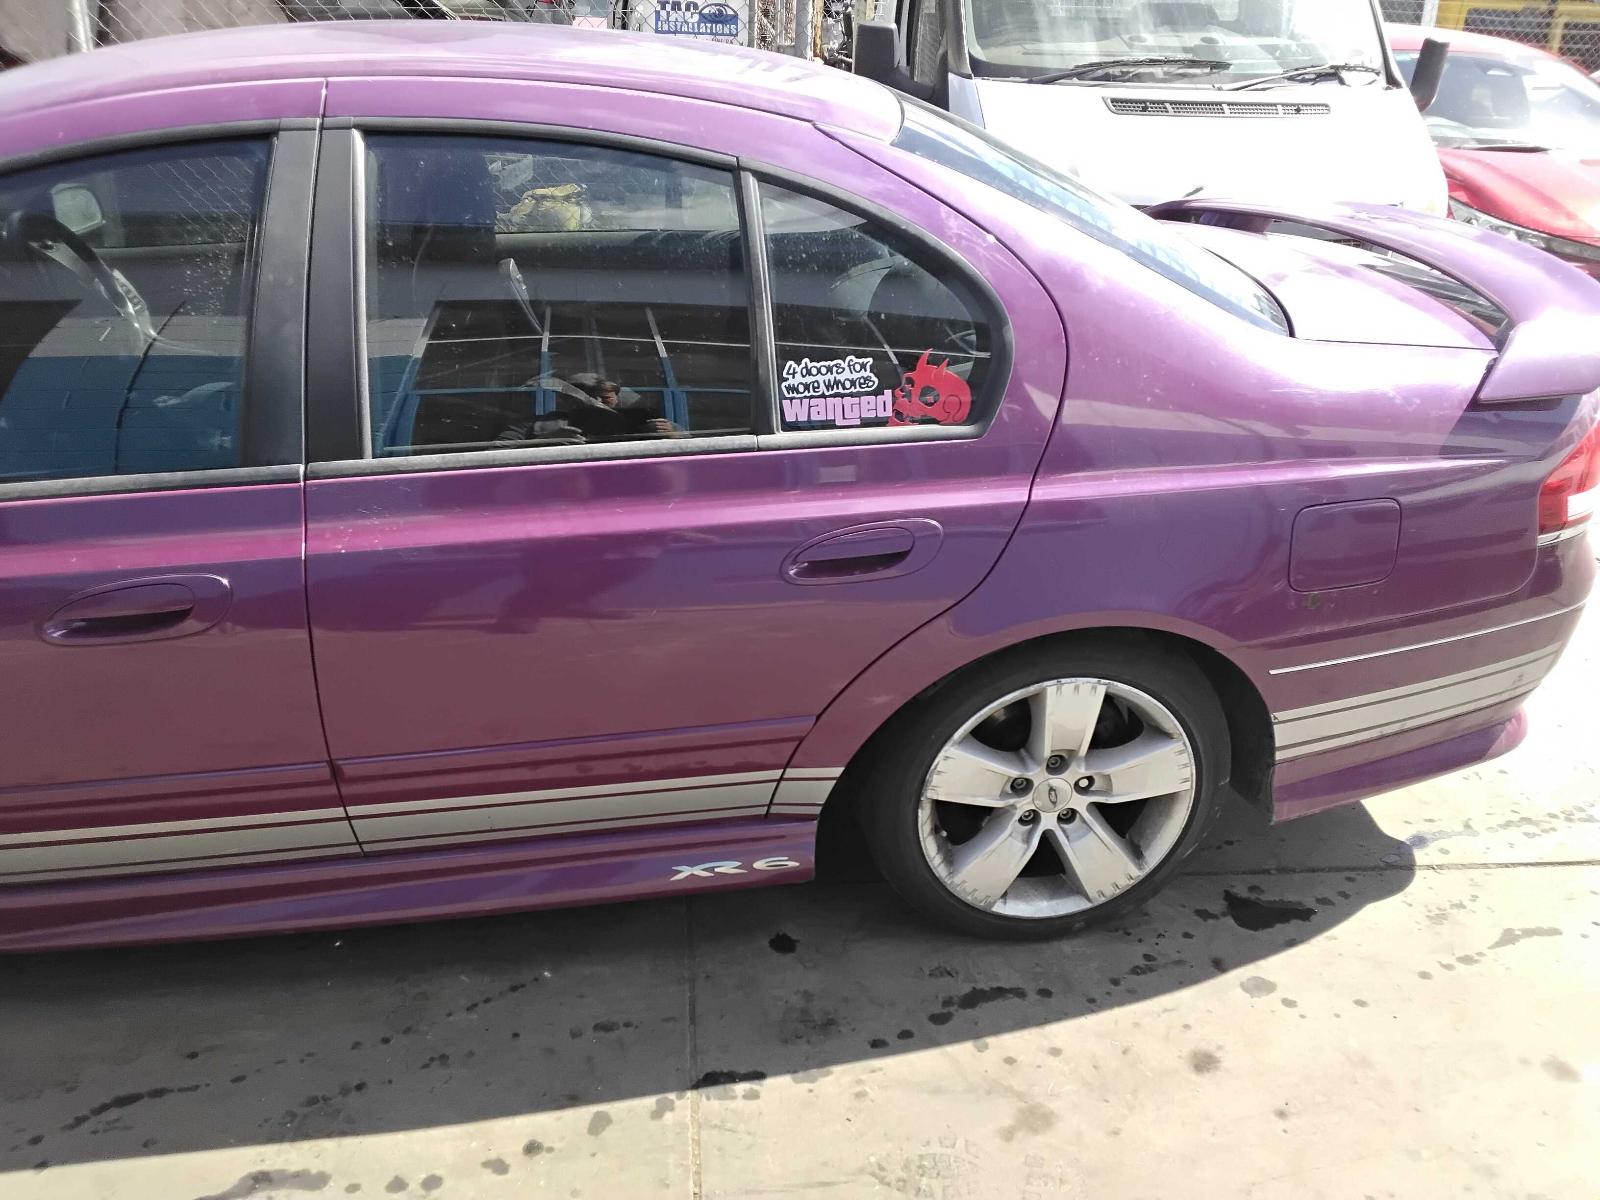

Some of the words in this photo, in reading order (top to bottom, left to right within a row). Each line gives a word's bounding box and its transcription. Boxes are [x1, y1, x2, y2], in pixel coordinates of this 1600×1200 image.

[657, 0, 699, 22] TAC
[658, 20, 737, 34] INSTALLATIONS
[786, 363, 798, 379] 4
[800, 361, 846, 378] doors
[847, 358, 870, 374] for
[784, 379, 821, 395] more
